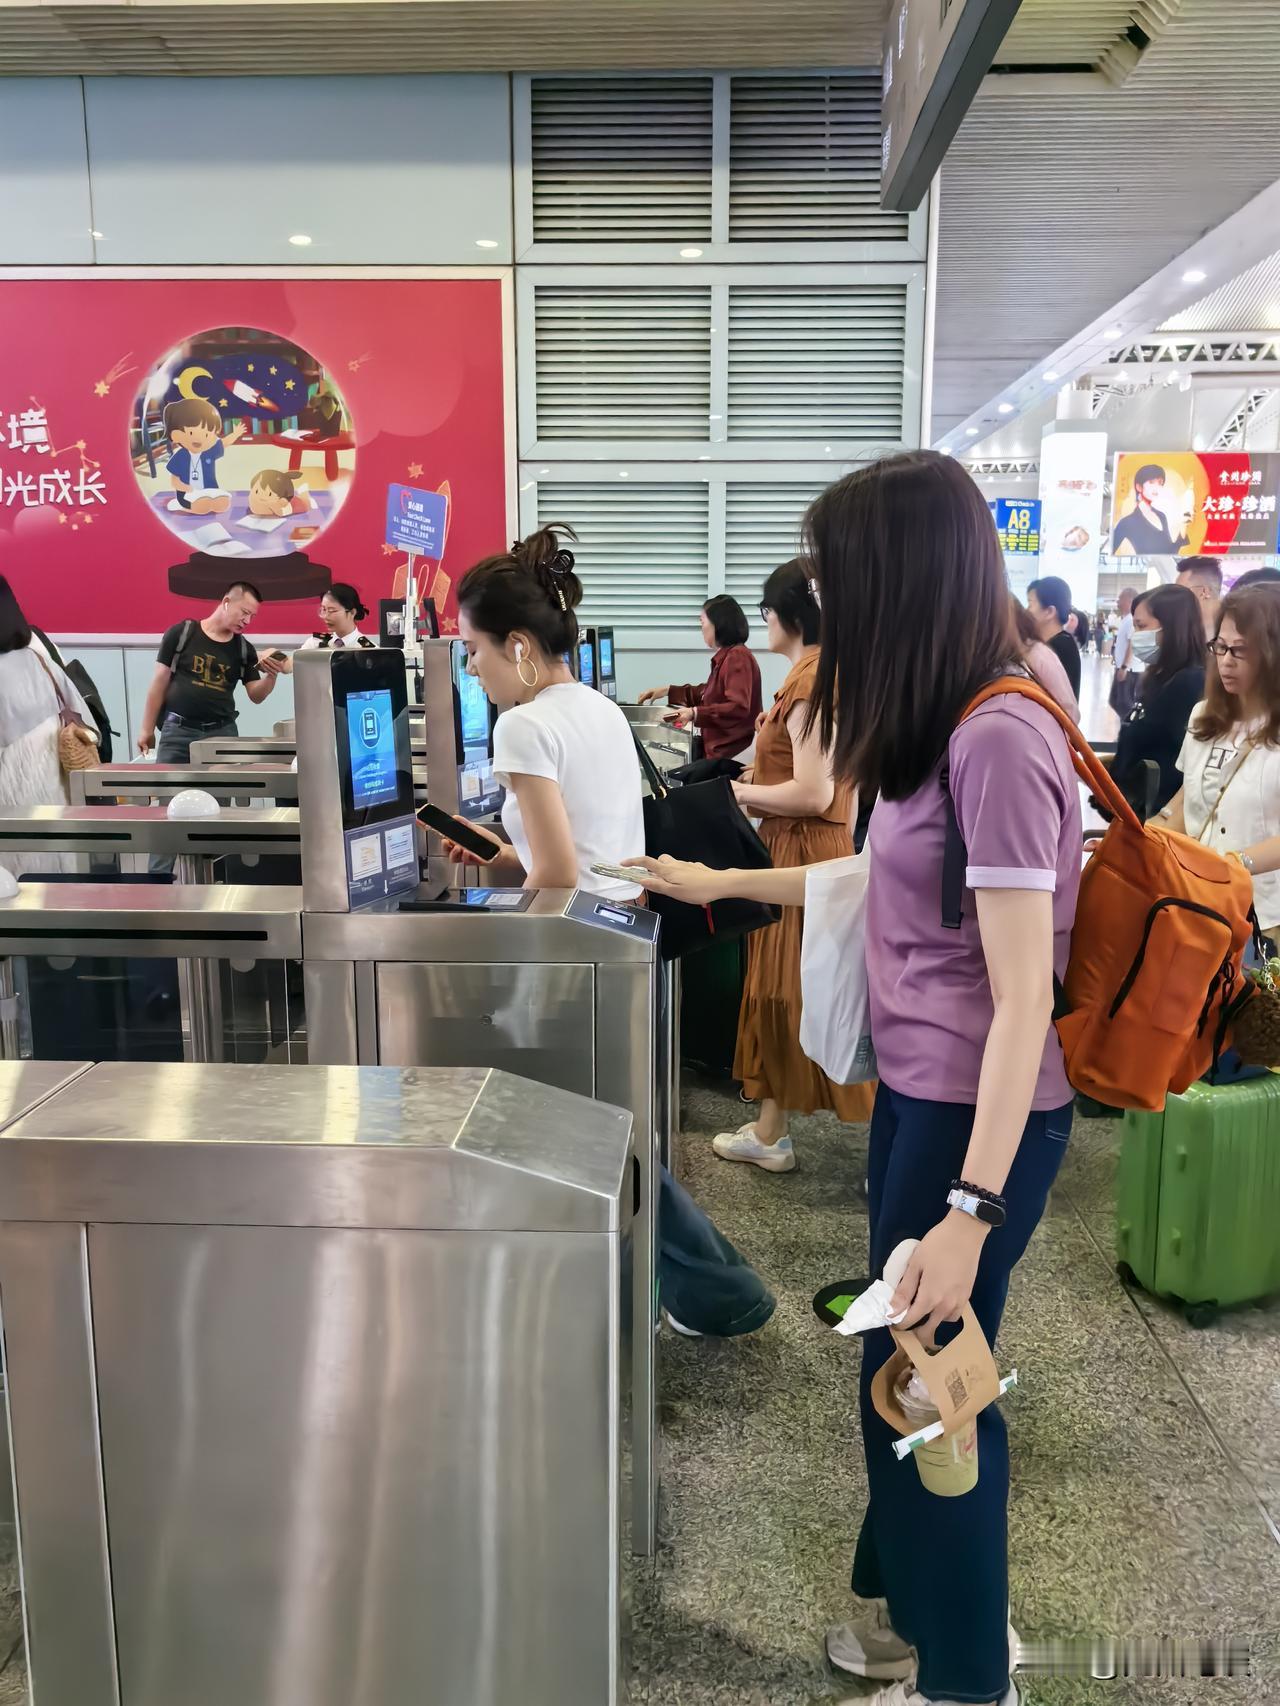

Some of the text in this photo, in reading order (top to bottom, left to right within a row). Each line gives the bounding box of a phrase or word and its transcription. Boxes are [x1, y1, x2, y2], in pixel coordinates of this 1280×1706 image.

[0, 409, 50, 454] 境
[0, 468, 108, 507] 光成长
[1007, 508, 1031, 530] A8
